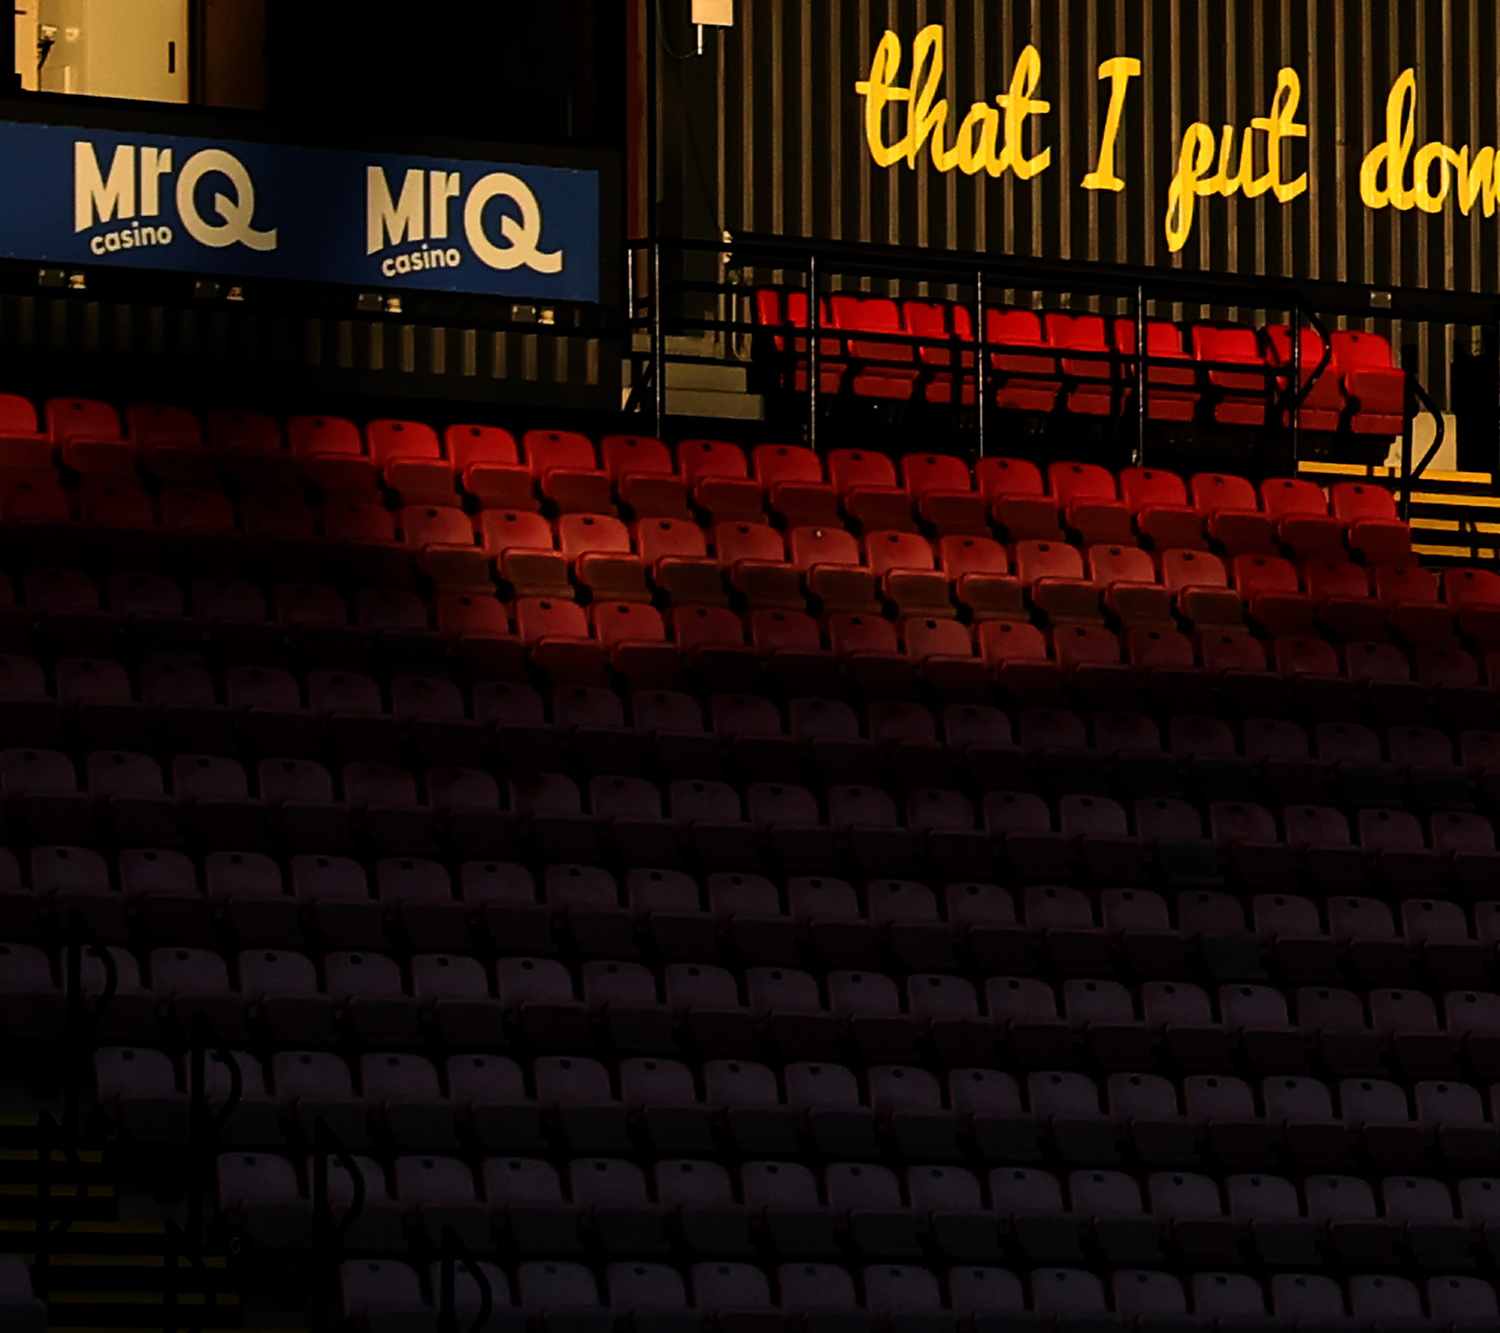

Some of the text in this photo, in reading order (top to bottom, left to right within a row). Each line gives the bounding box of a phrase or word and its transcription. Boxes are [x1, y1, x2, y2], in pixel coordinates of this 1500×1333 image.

[855, 23, 1051, 181] that
[1080, 56, 1141, 191] I
[1165, 67, 1308, 252] put
[75, 141, 278, 251] MrQ
[89, 222, 172, 256] casino
[367, 166, 563, 274] MrQ
[381, 244, 461, 278] casino
